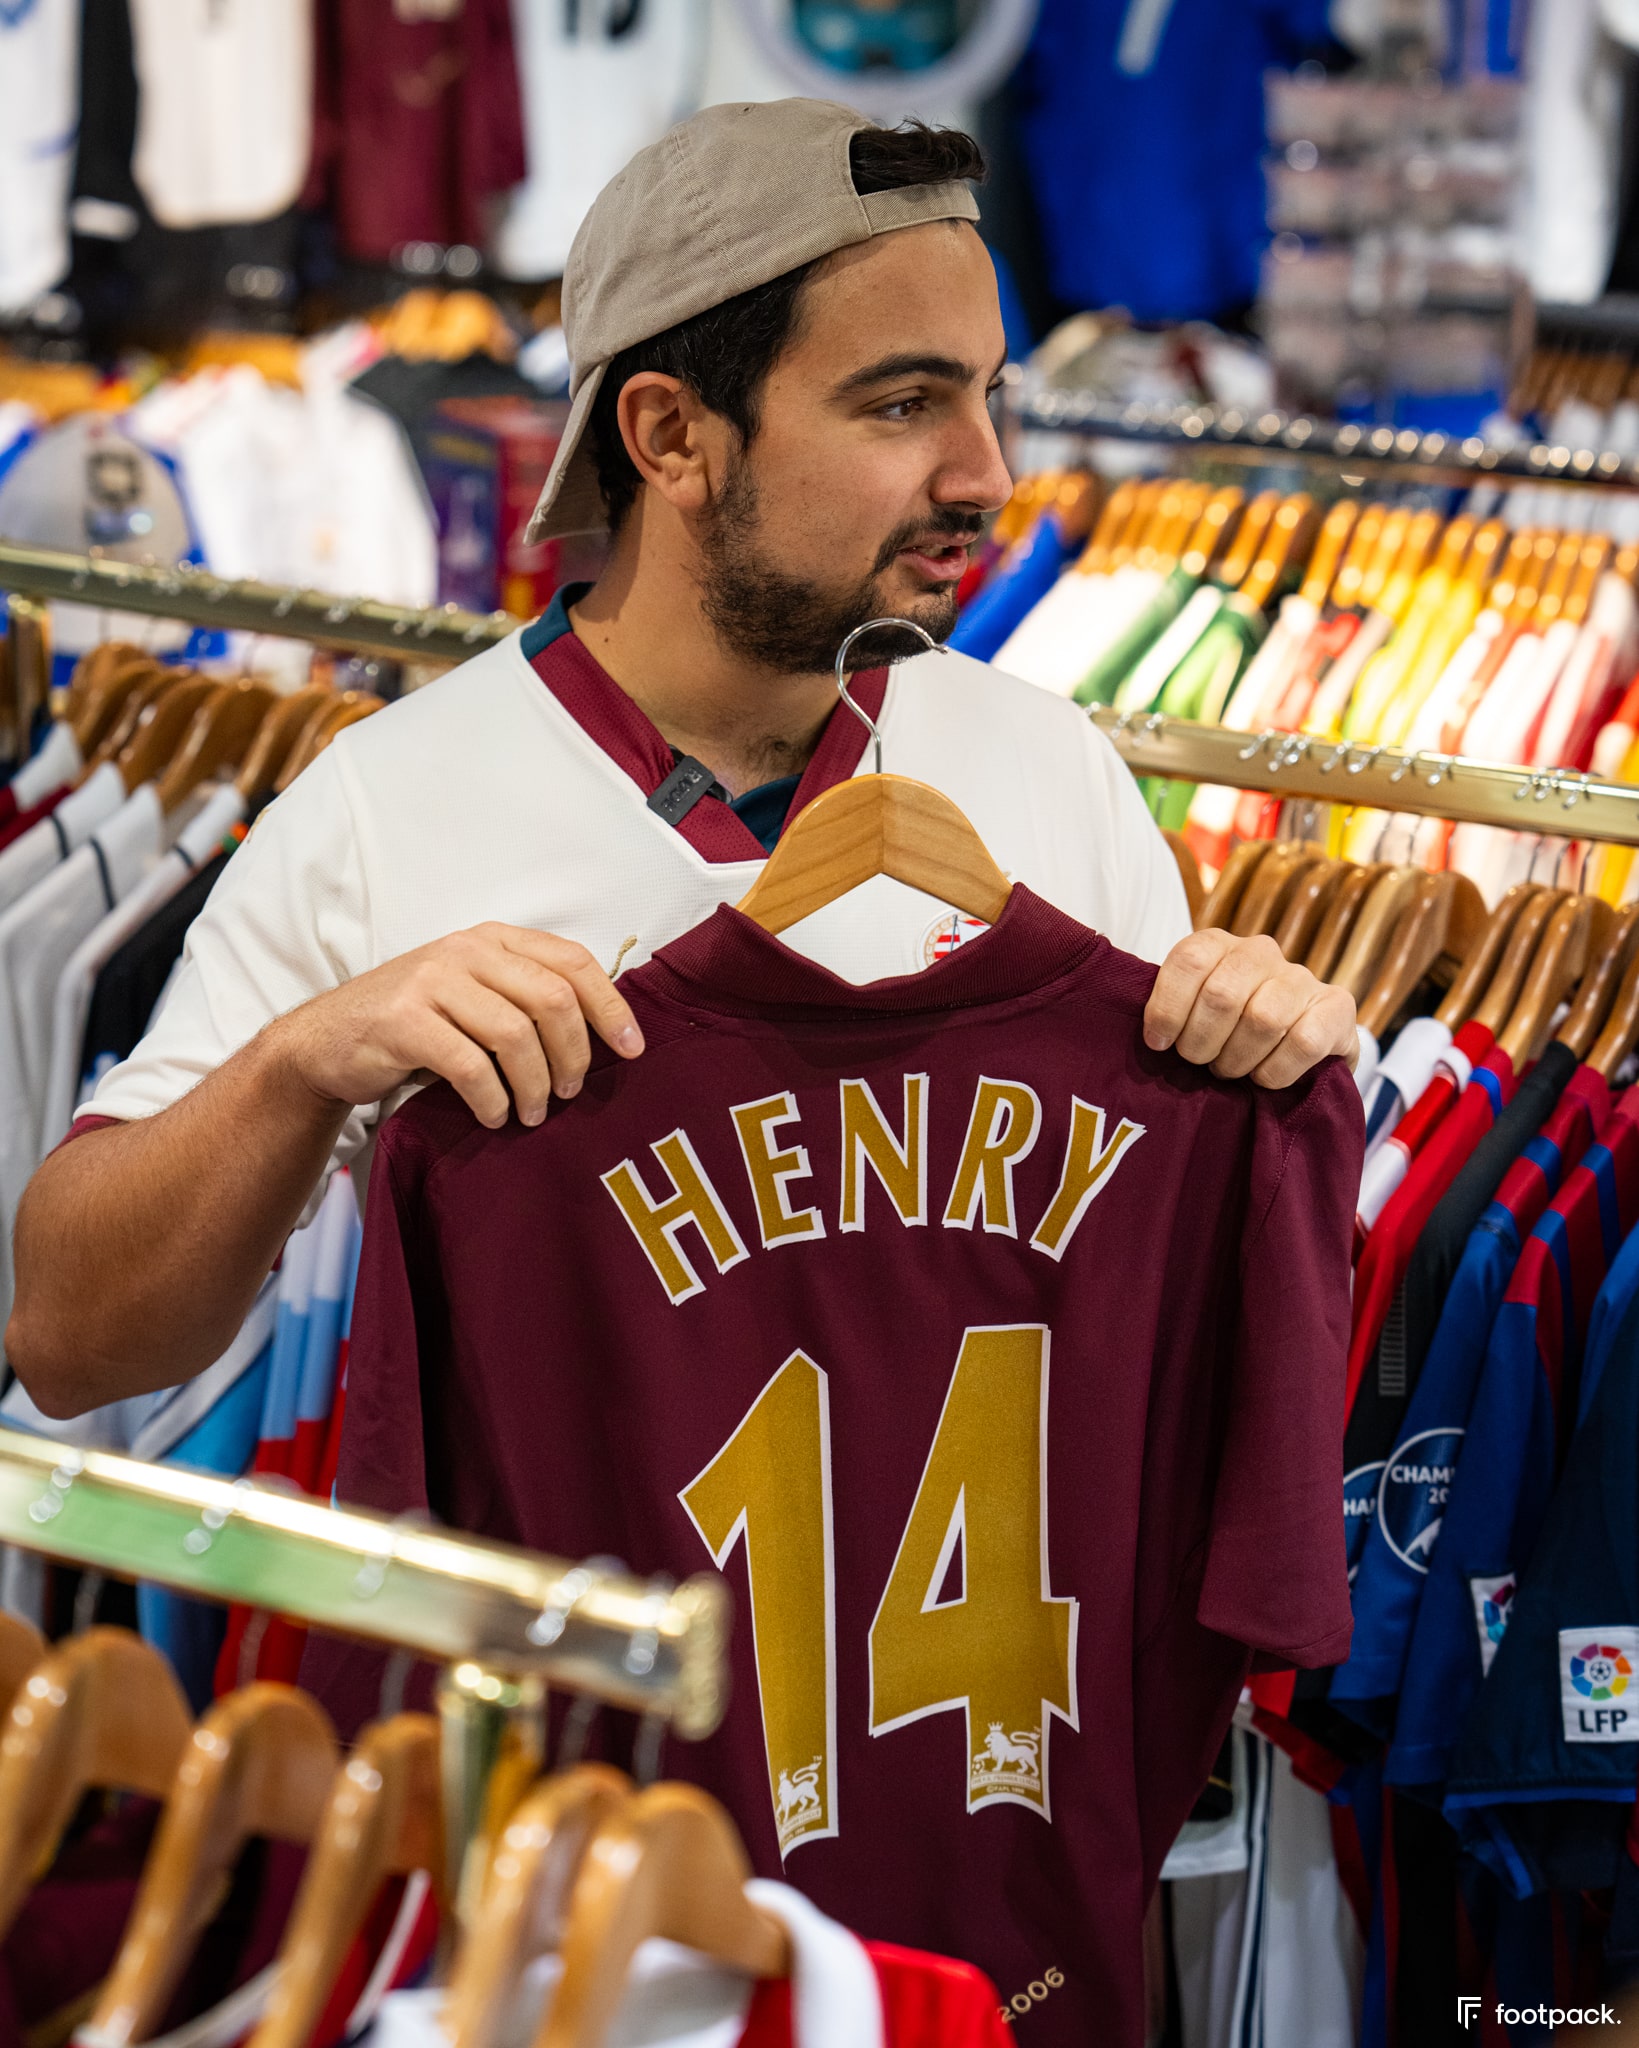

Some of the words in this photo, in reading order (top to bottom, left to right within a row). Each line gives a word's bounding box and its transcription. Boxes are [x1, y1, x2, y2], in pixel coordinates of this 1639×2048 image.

[599, 1072, 1148, 1306] HENRY
[677, 1323, 1080, 1875] 14
[1578, 1709, 1628, 1733] LFP
[997, 1966, 1065, 2024] 2006
